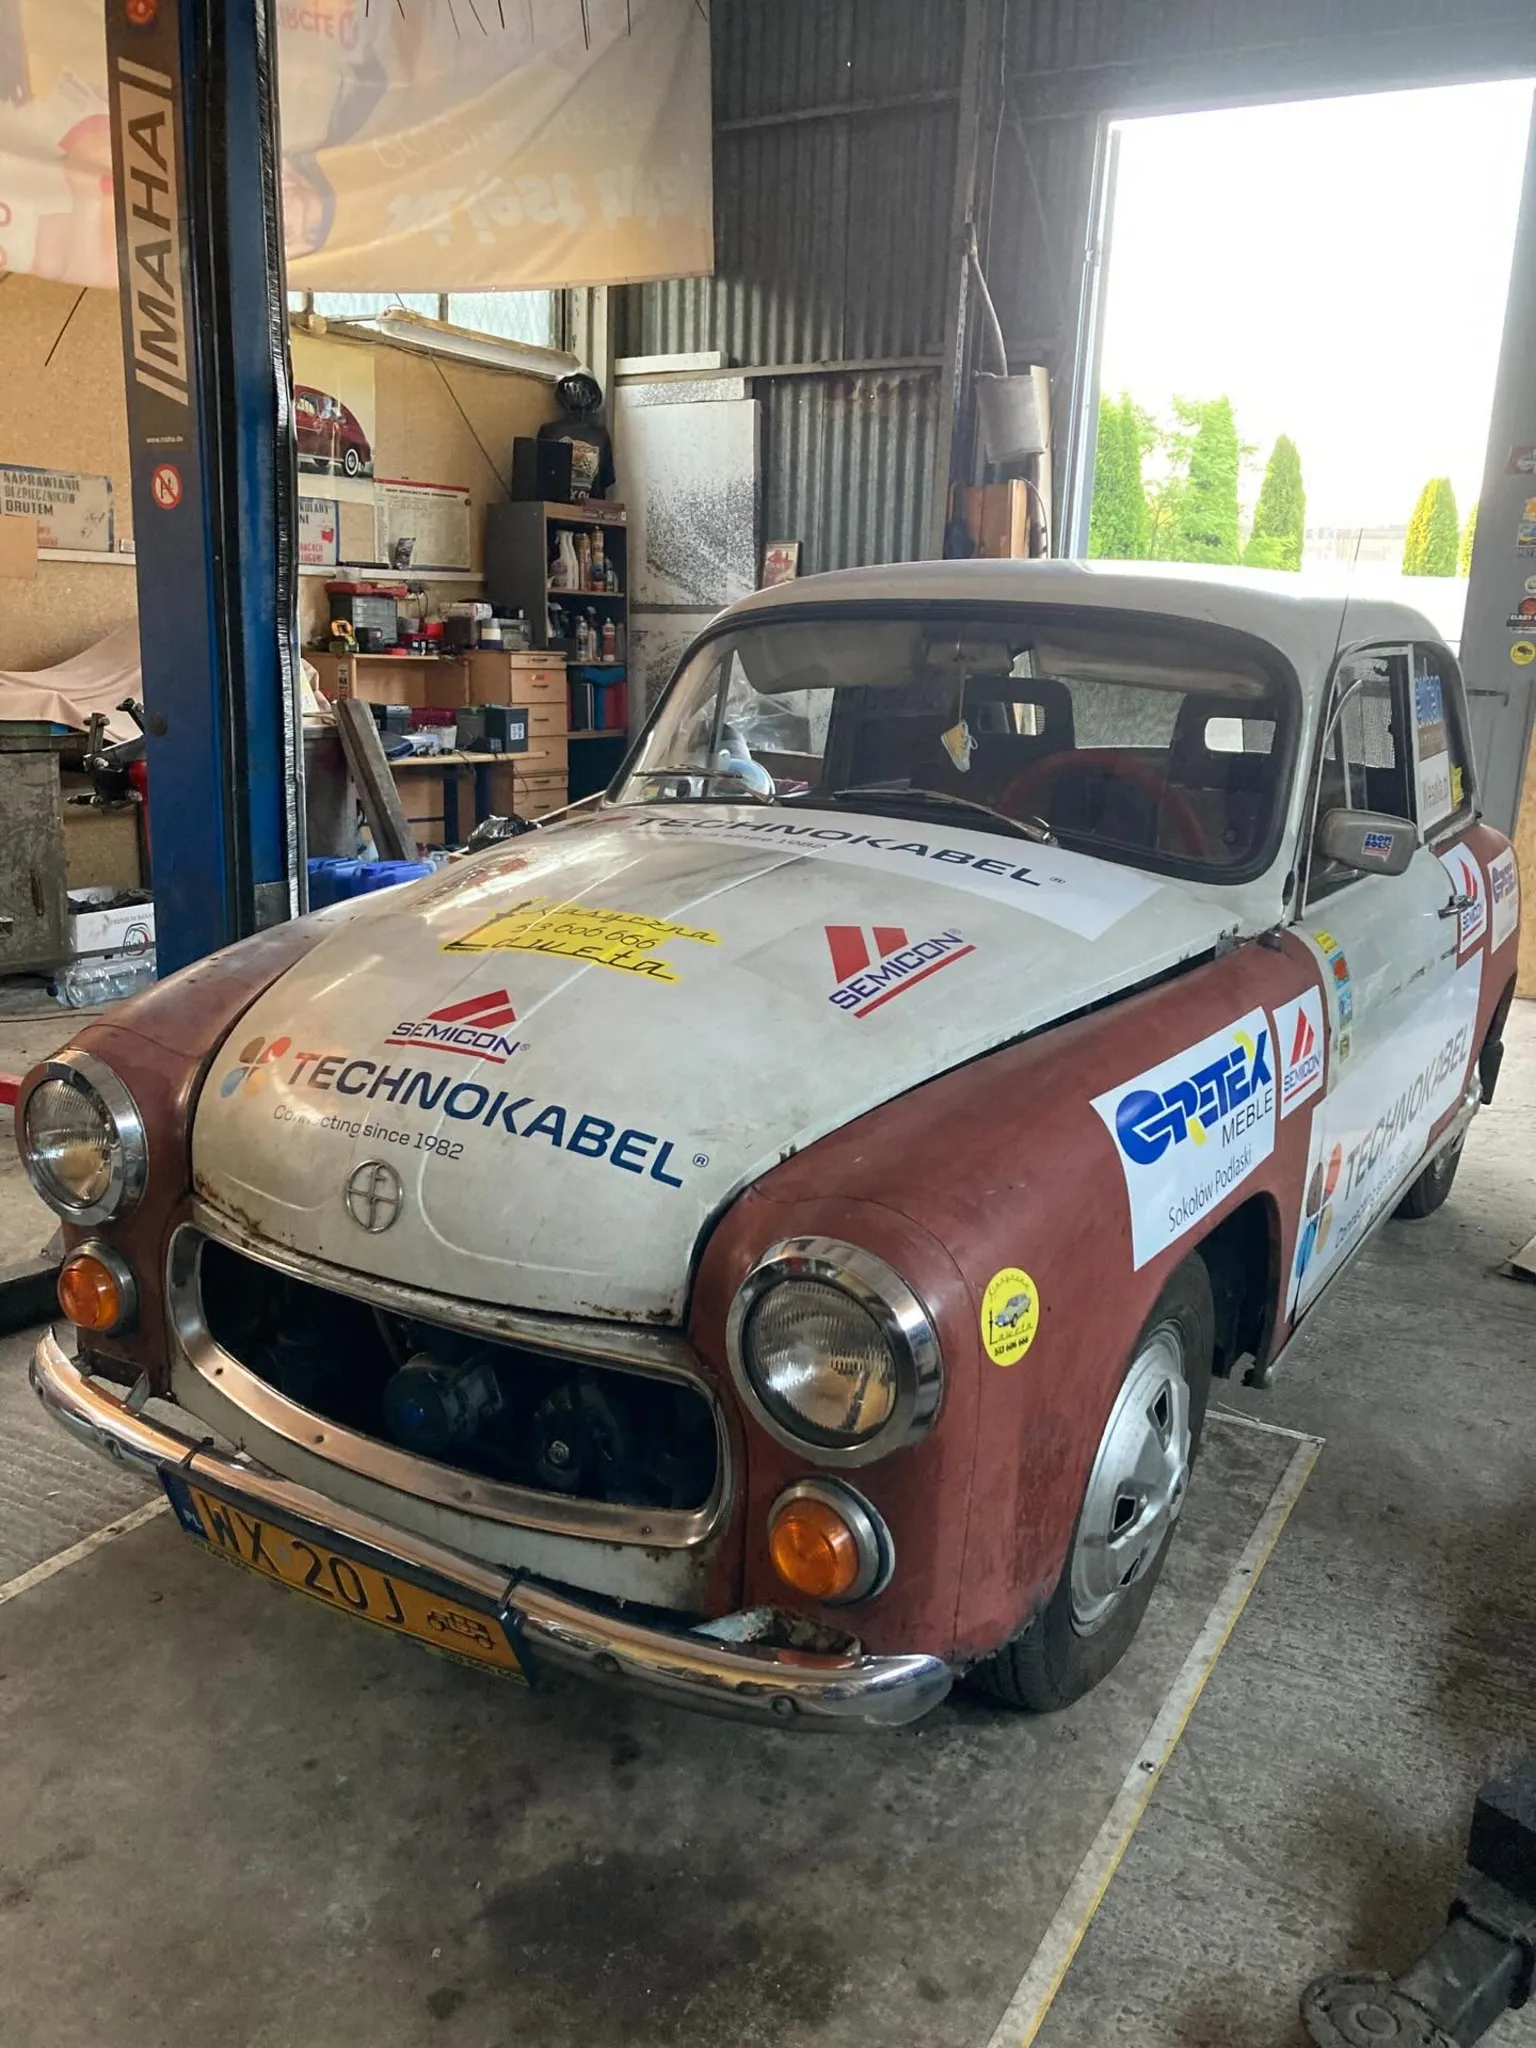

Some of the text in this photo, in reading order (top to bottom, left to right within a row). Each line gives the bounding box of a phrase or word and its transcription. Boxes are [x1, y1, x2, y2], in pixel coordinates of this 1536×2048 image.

[129, 110, 179, 367] MAHA
[637, 816, 1042, 887] TECHNOKABEL
[554, 922, 608, 938] 606
[605, 926, 660, 950] 666
[829, 931, 966, 1011] SEMICON
[392, 1021, 520, 1058] SEMICON
[1284, 1055, 1320, 1092] SEMICON
[287, 1051, 683, 1189] TECHNOKABEL
[363, 1122, 410, 1146] since
[413, 1132, 464, 1161] 1982
[1221, 1088, 1273, 1149] MEBLE
[1346, 1023, 1469, 1200] TECHNOKABEL
[1168, 1143, 1252, 1233] Sokołów Podlaski
[182, 1508, 204, 1530] PL
[198, 1493, 280, 1575] WX
